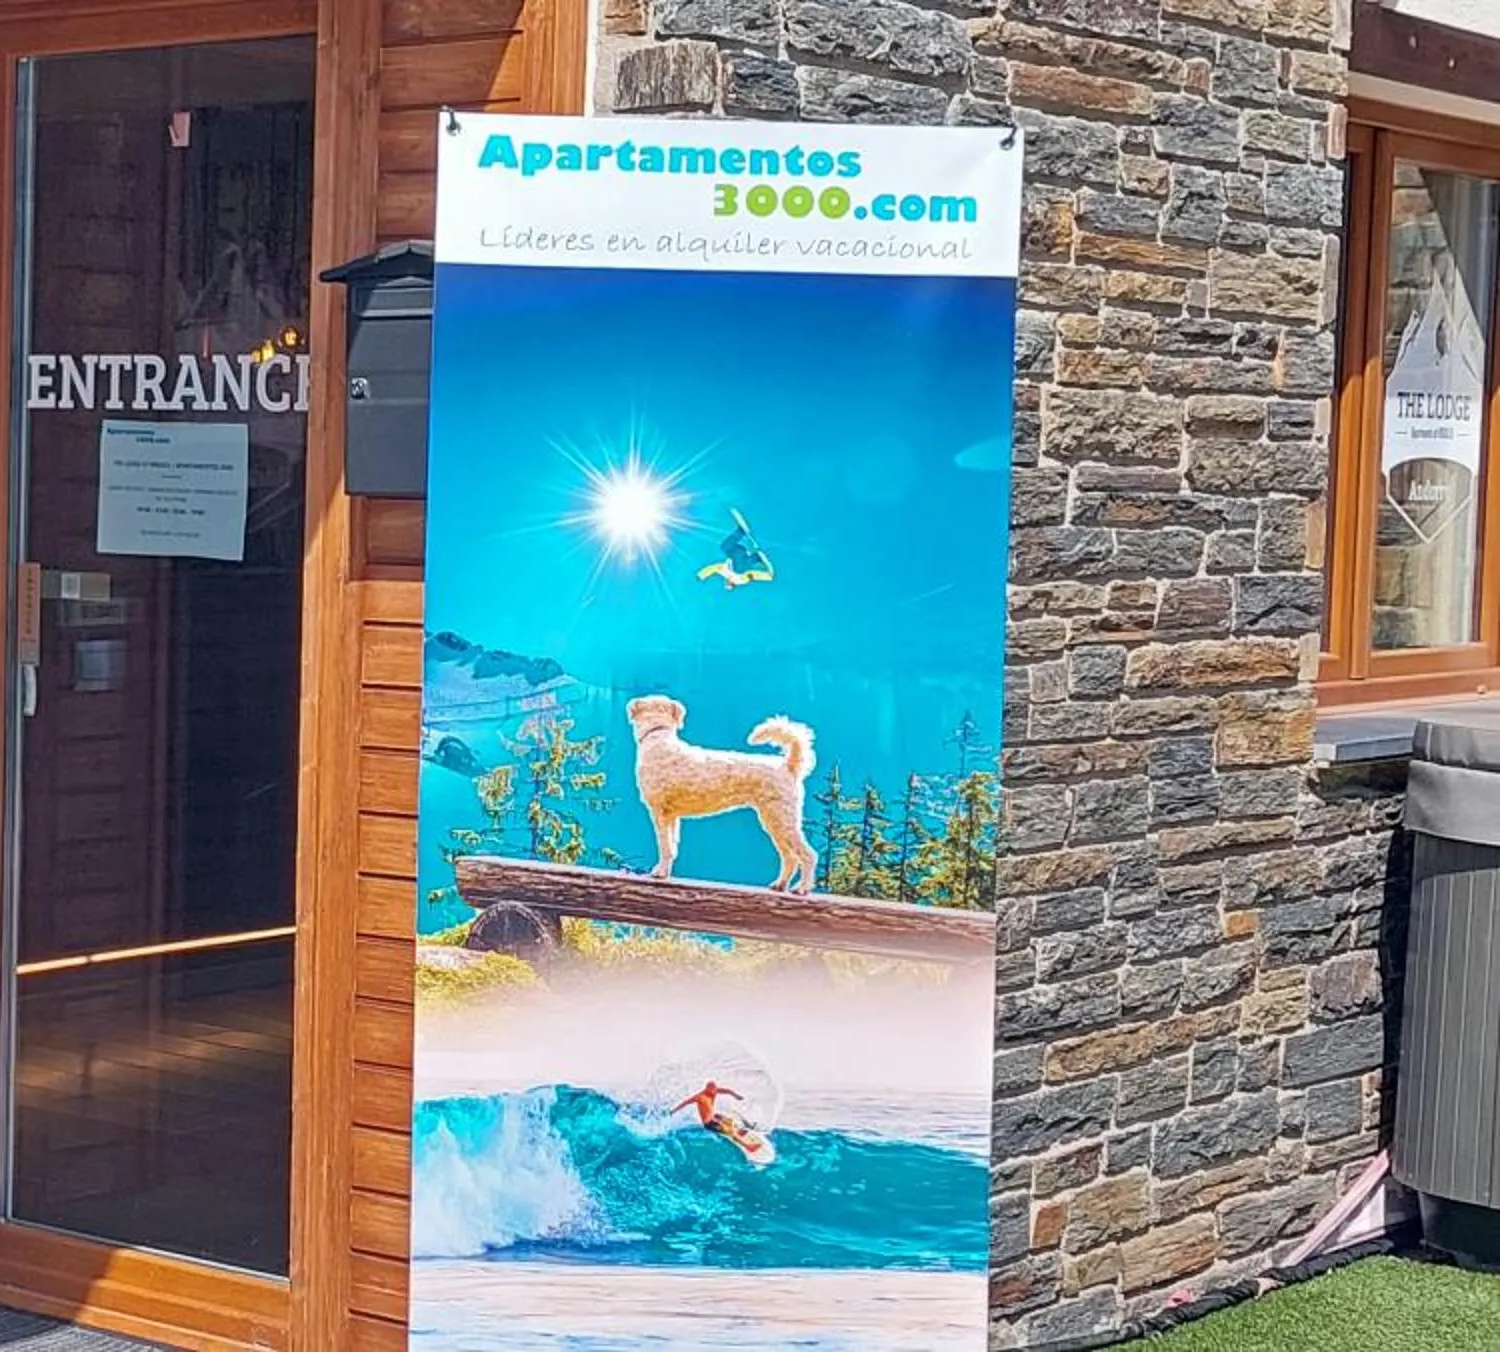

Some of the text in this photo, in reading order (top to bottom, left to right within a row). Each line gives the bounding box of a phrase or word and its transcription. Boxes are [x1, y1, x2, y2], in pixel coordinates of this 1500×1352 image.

[477, 134, 863, 177] Apartamentos
[713, 183, 978, 222] 3000.com
[479, 225, 973, 262] Líderes en alquiler vacacional
[1397, 391, 1472, 421] THE LODGE
